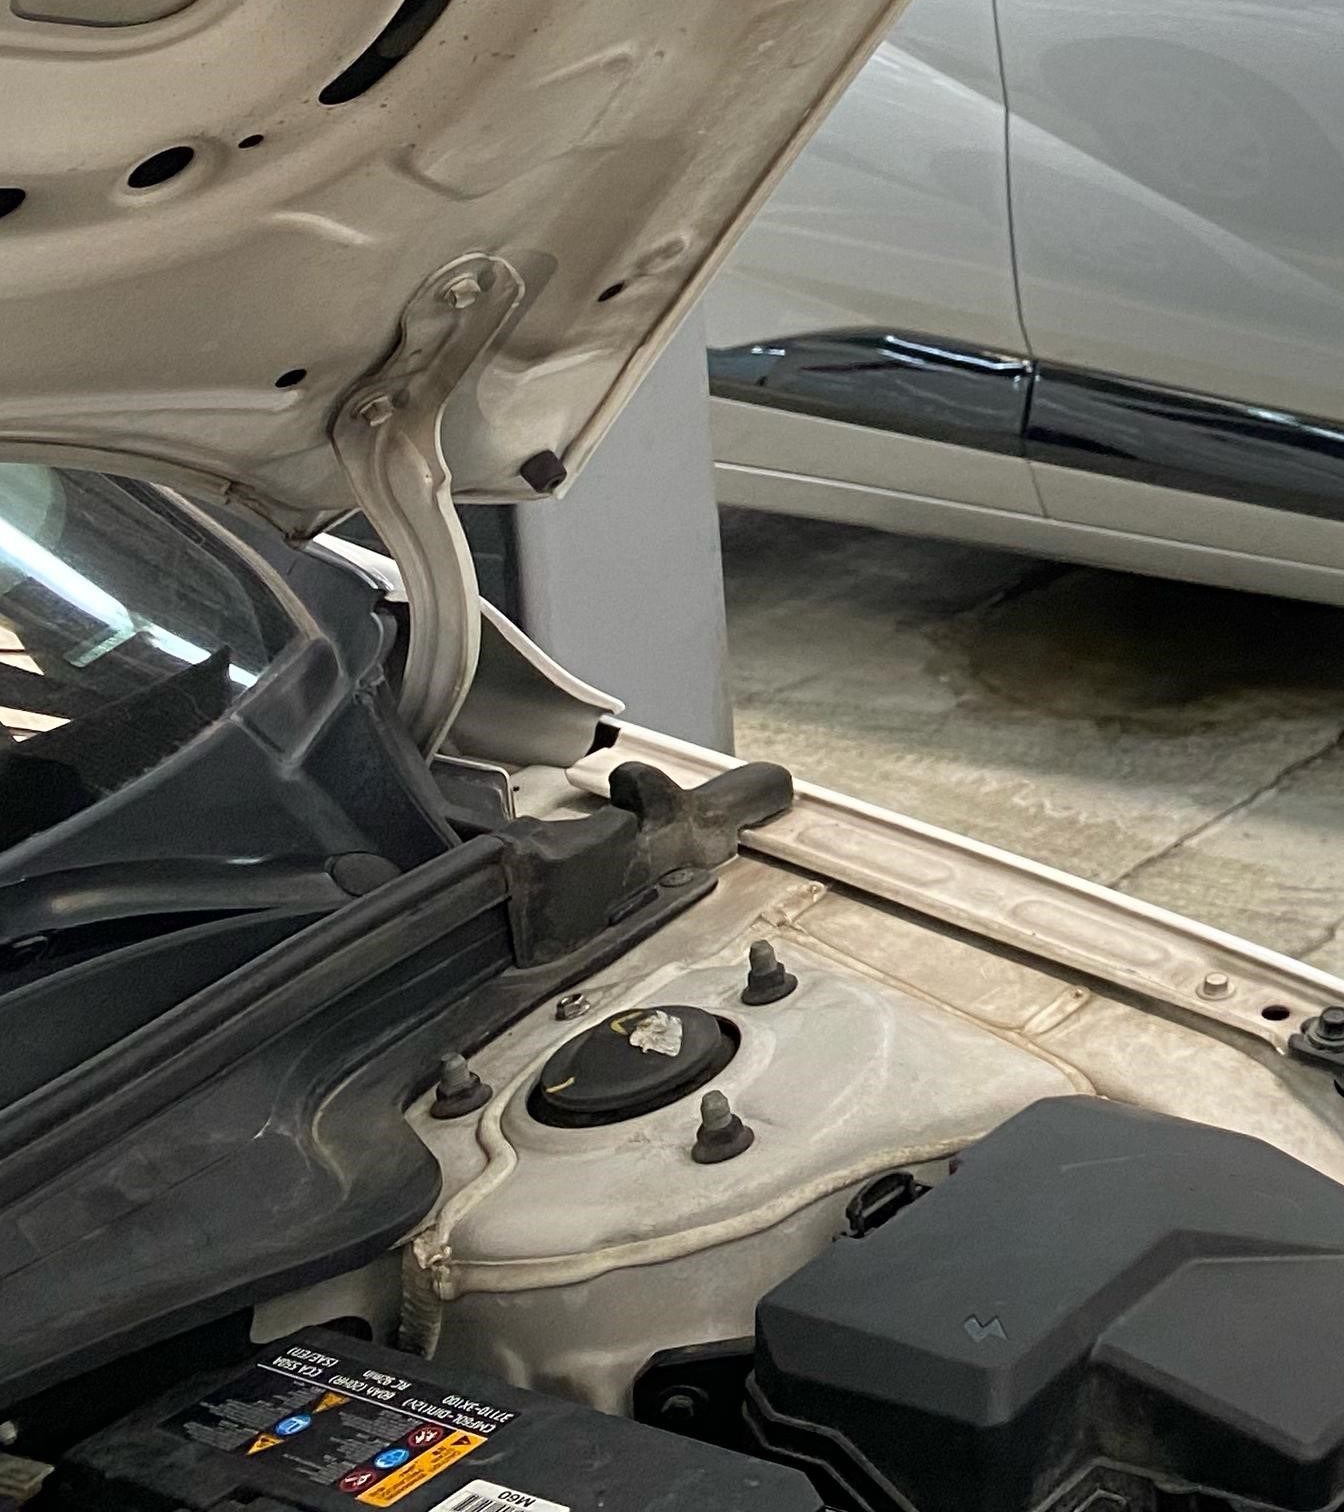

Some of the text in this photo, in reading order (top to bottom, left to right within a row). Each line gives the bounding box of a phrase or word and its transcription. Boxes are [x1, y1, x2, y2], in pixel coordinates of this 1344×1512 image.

[299, 1363, 323, 1378] CCA
[393, 1378, 412, 1391] RC
[441, 1393, 514, 1423] 37110-3X100
[498, 1490, 537, 1509] M60
